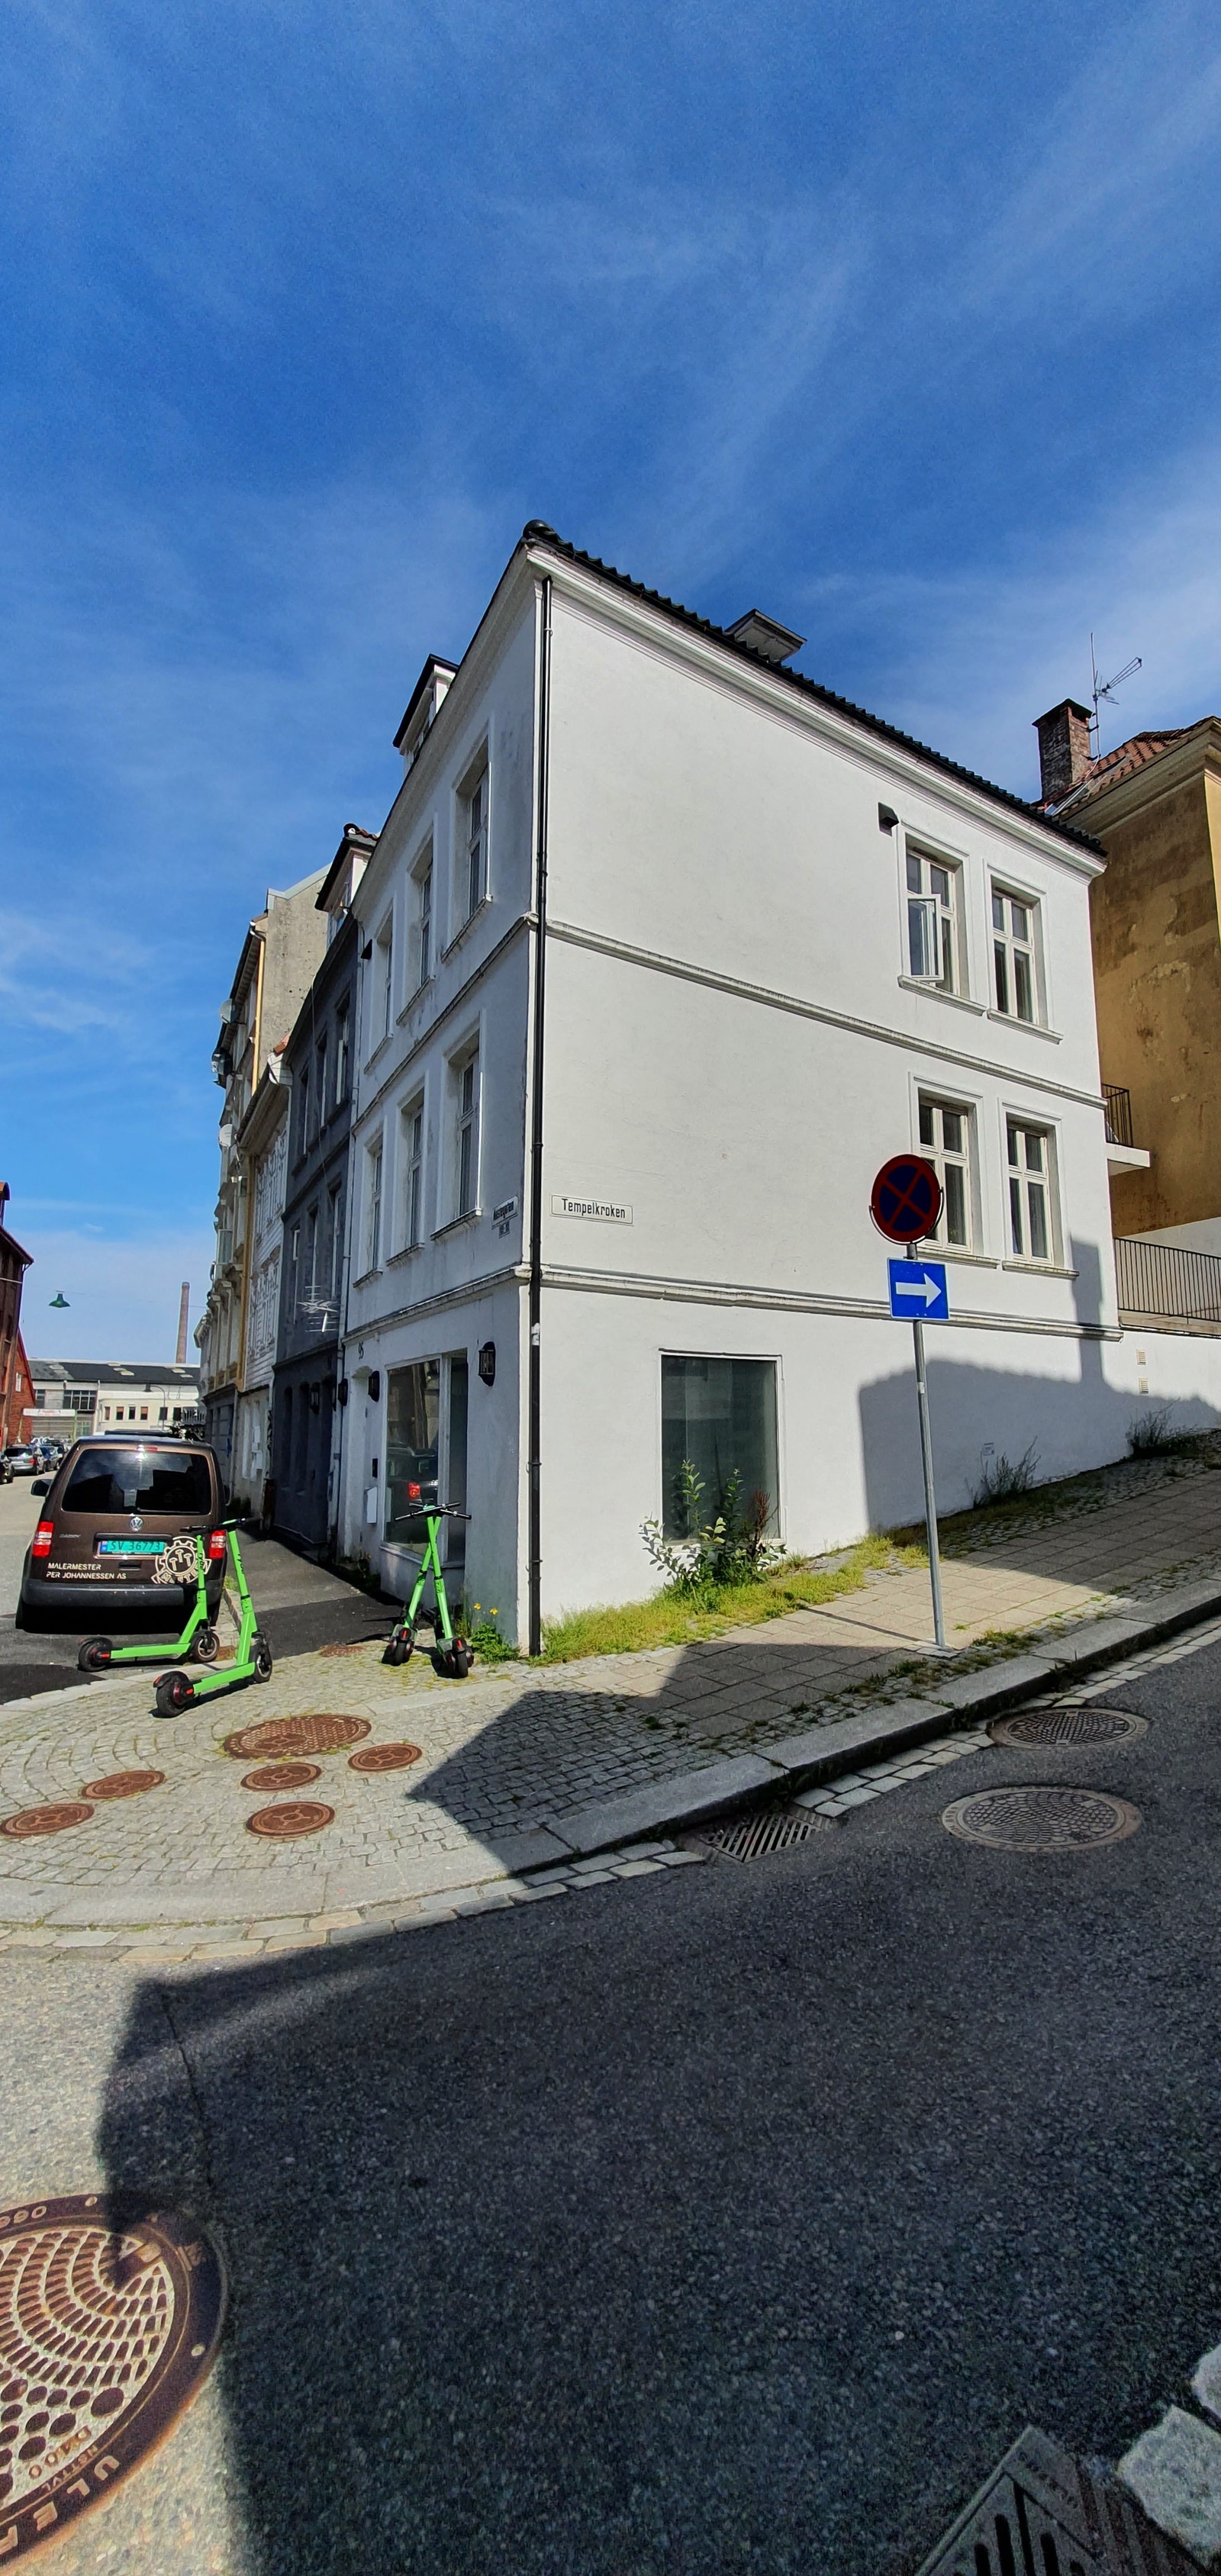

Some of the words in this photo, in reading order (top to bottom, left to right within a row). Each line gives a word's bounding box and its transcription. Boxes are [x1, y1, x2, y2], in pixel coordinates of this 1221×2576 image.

[562, 1198, 626, 1219] Tempelkroken
[110, 1541, 124, 1550] SV
[129, 1541, 160, 1551] 36773
[47, 1562, 101, 1570] MALERMESTER
